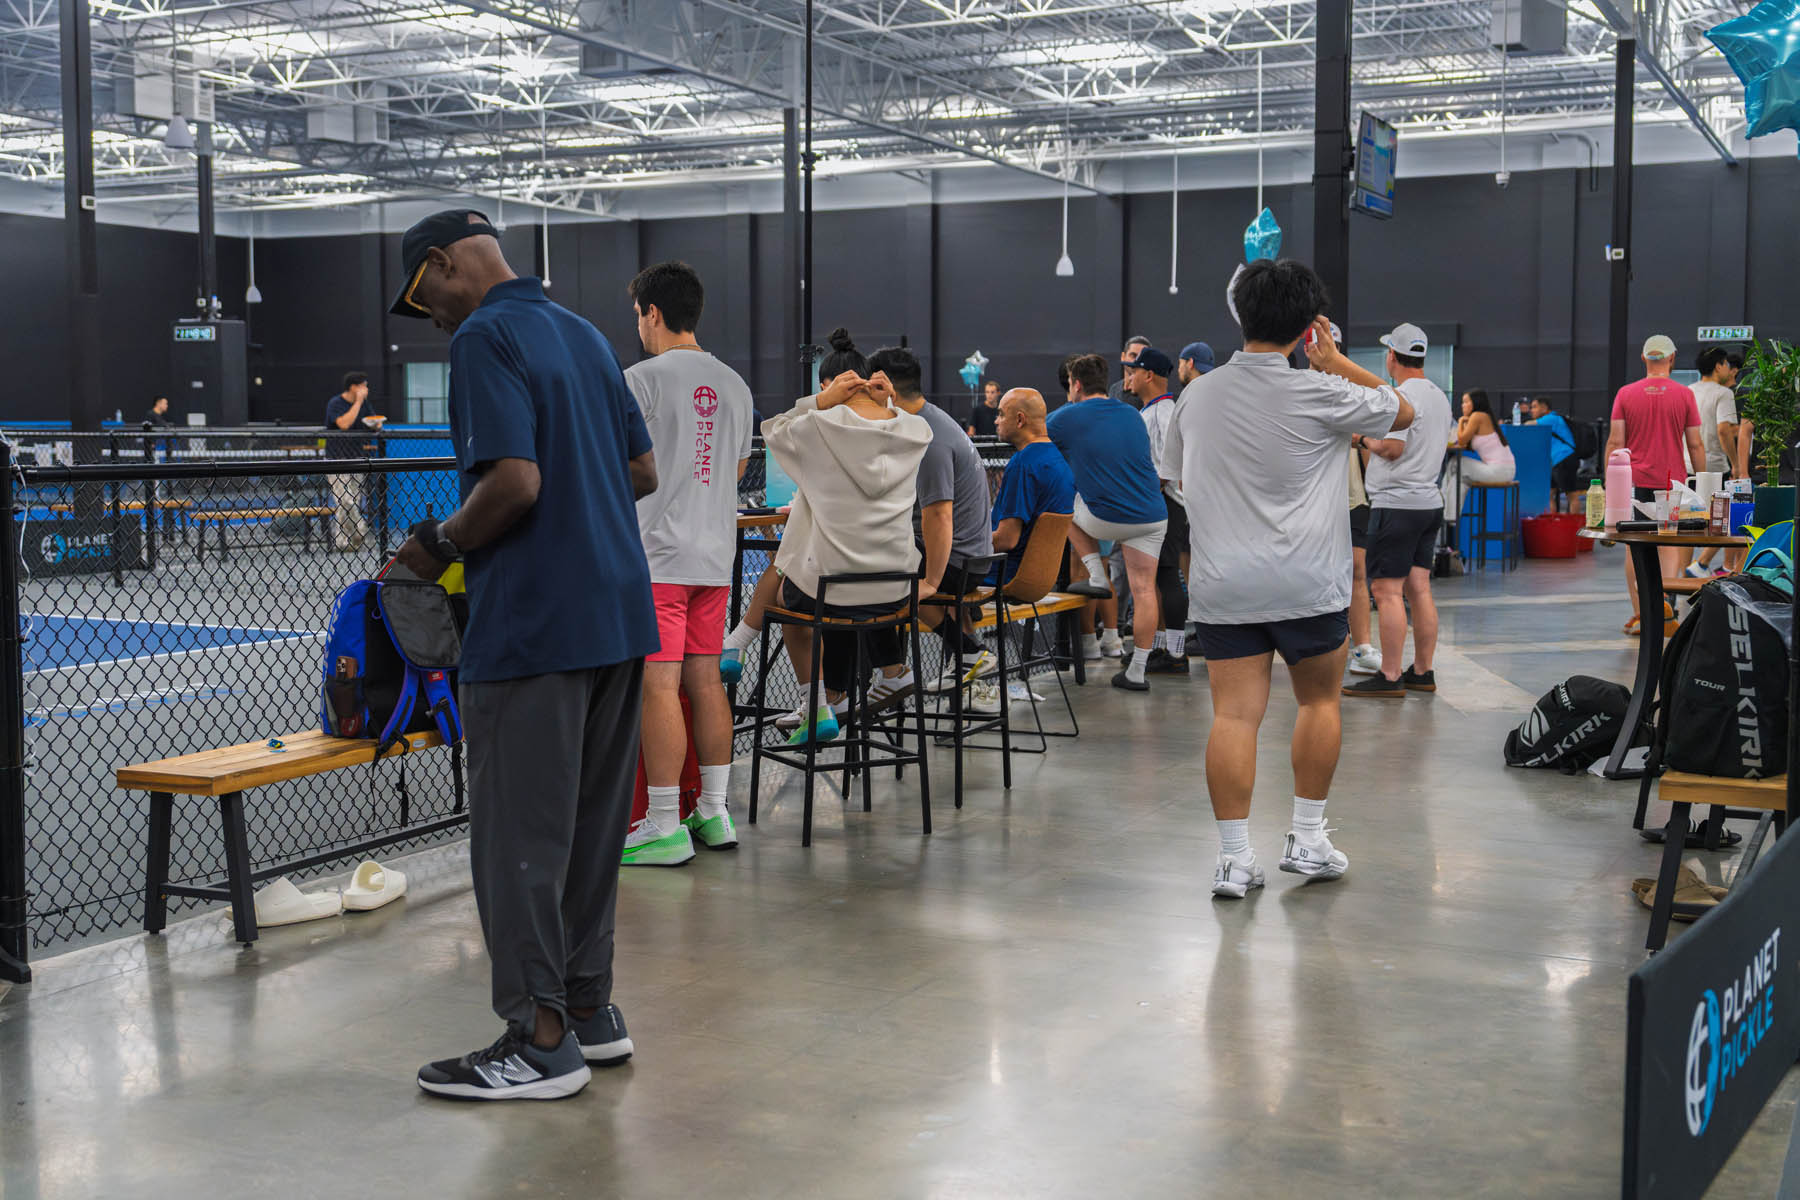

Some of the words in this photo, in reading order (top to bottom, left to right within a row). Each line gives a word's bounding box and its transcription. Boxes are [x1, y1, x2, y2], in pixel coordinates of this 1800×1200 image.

[694, 421, 704, 480] PICKLE
[701, 421, 713, 487] PLANET
[1694, 678, 1726, 691] TOUR
[1727, 603, 1763, 779] SELKIRK
[1512, 712, 1612, 767] ELKIRK
[1723, 928, 1780, 1035] PLANET
[1720, 984, 1774, 1091] PICKLE
